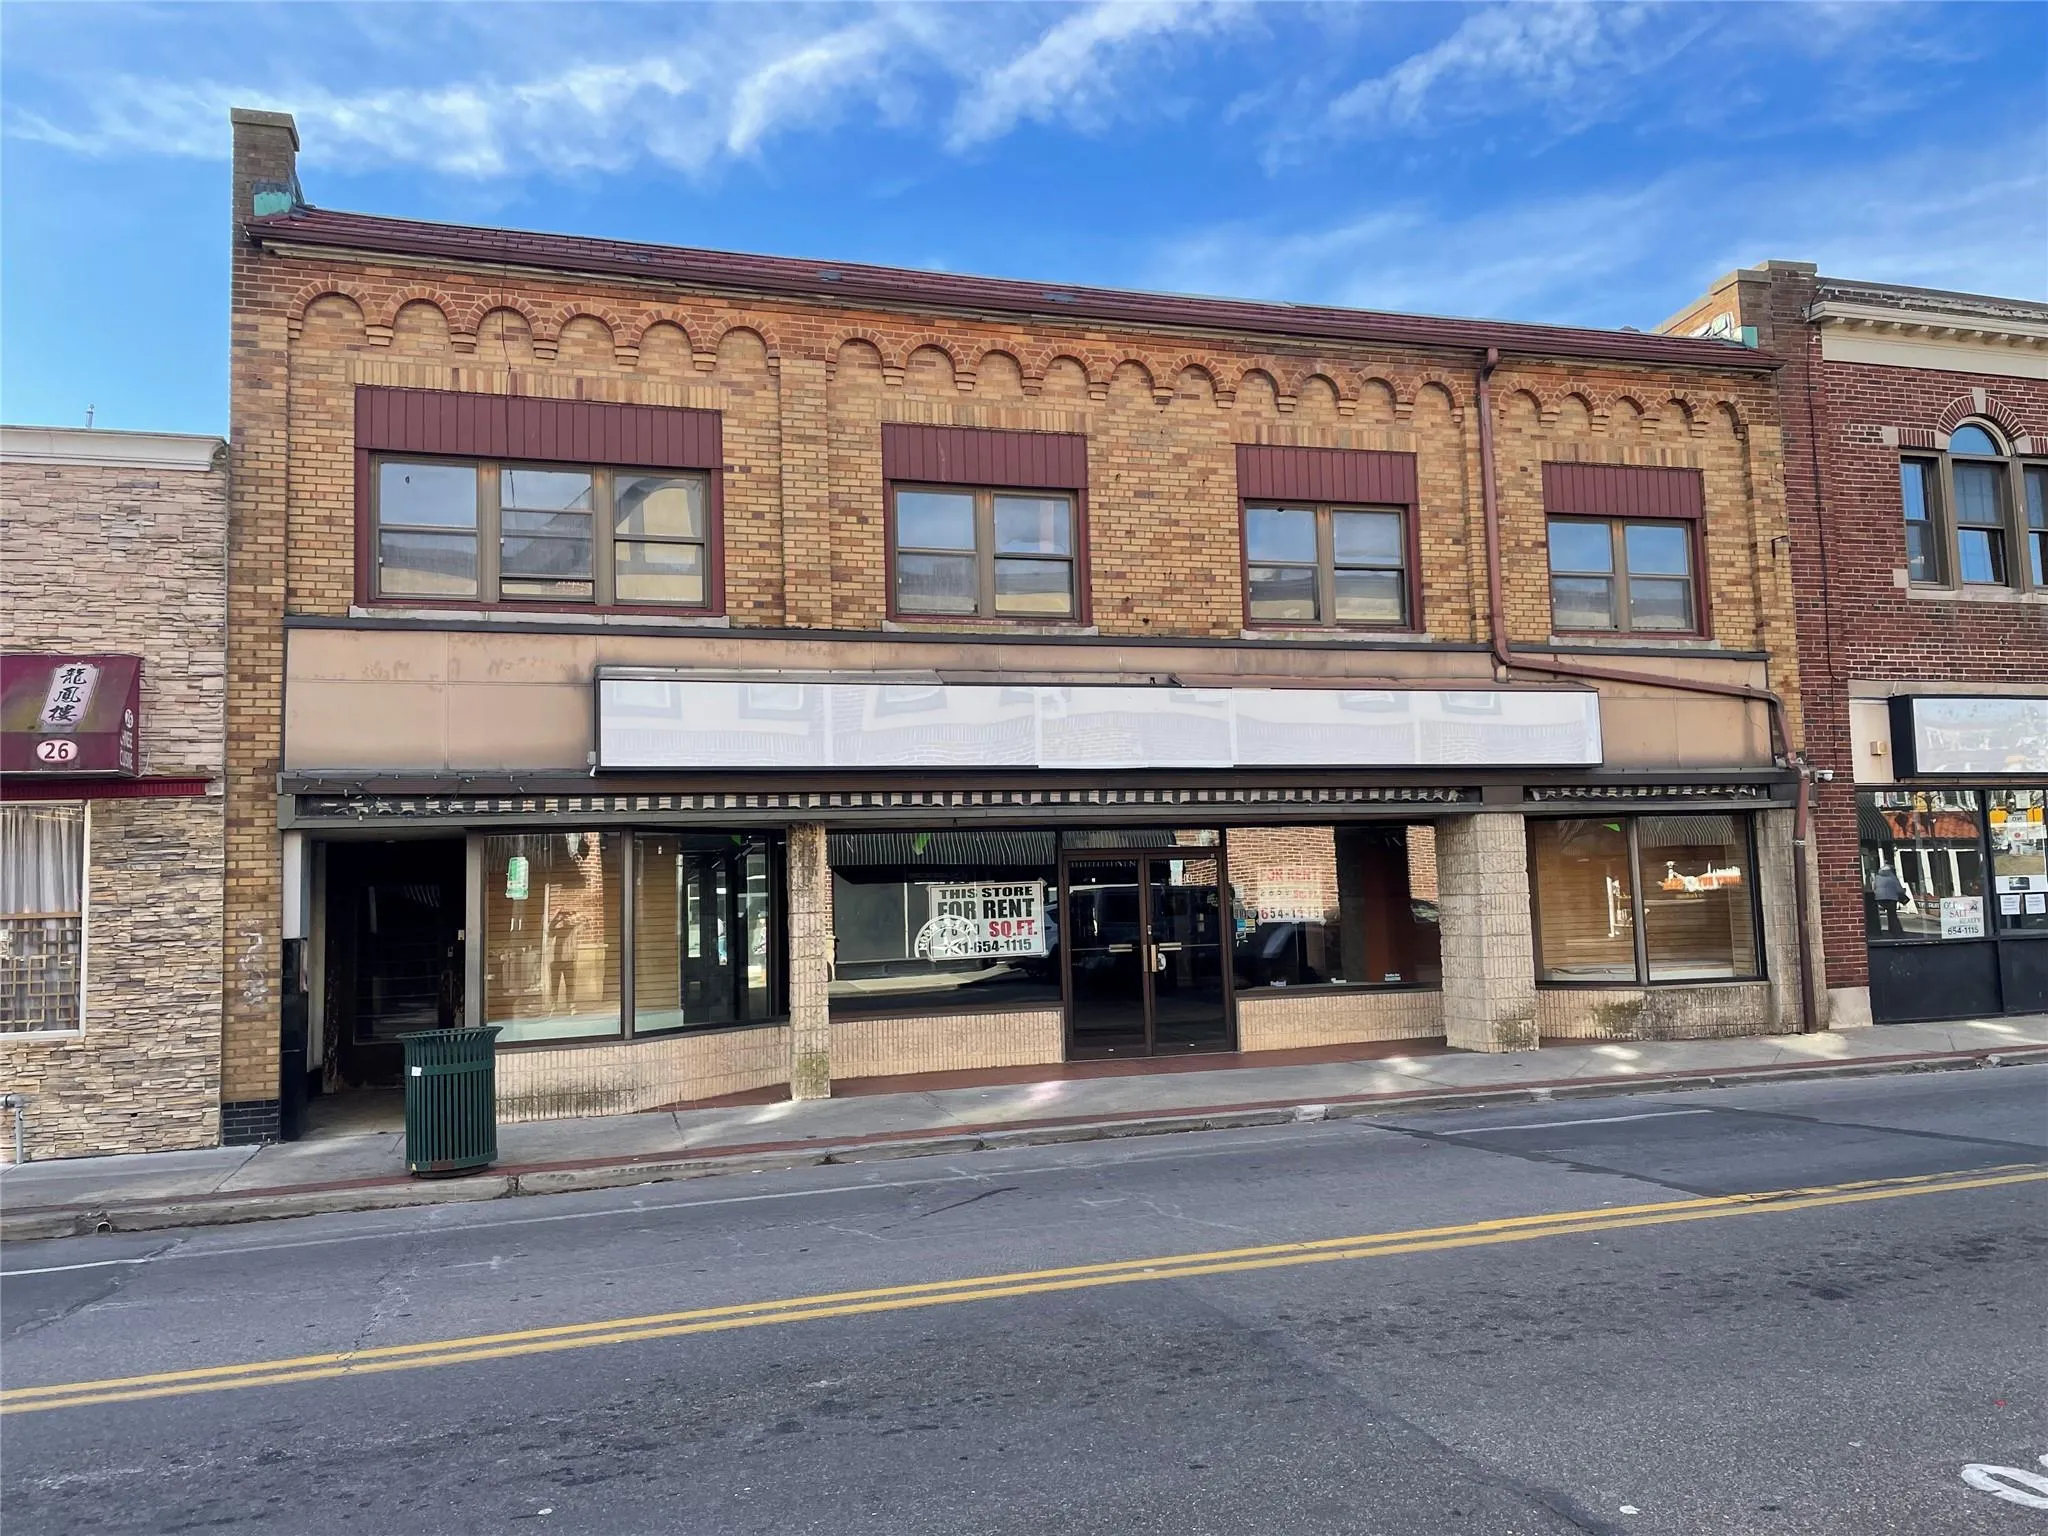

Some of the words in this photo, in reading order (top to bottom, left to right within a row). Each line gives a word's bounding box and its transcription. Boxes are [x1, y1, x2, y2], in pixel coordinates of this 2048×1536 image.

[44, 742, 69, 759] 26
[940, 888, 977, 899] THIS
[982, 886, 1032, 897] STORE
[938, 901, 976, 919] FOR
[983, 898, 1034, 919] RENT
[988, 920, 1038, 937] SQ.FT.
[1947, 927, 1979, 935] 654-1115
